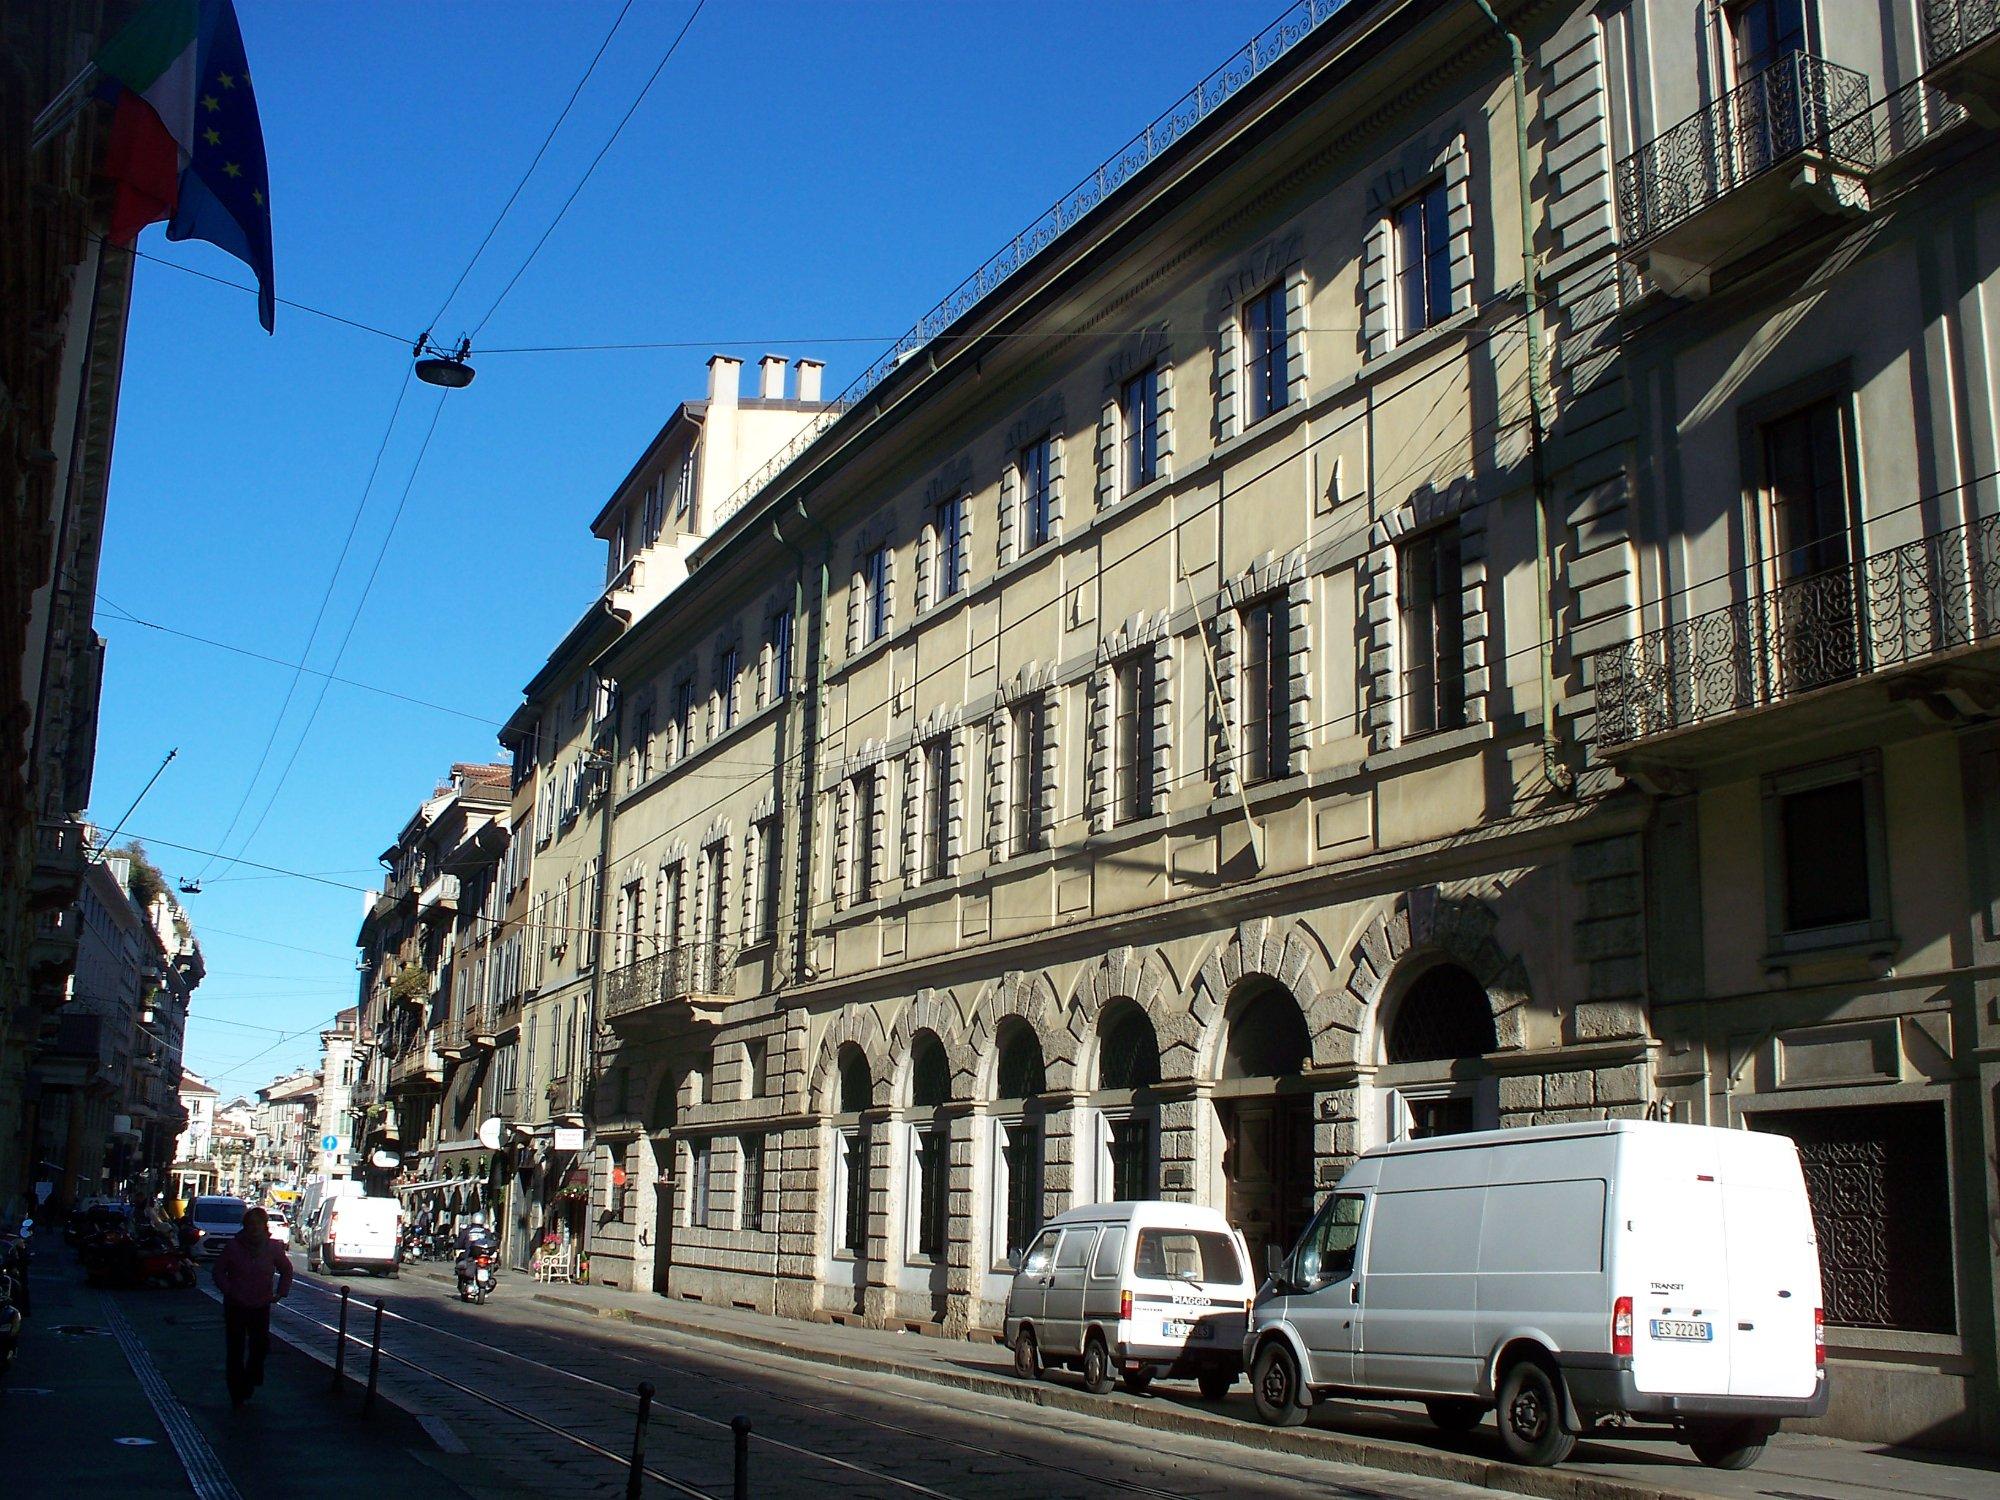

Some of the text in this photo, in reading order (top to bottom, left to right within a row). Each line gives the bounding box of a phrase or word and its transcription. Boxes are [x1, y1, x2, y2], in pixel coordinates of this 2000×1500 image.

[1650, 1282, 1684, 1290] TRANSIT
[1172, 1296, 1212, 1306] PIAGGIO
[1658, 1321, 1706, 1337] ES 222AB
